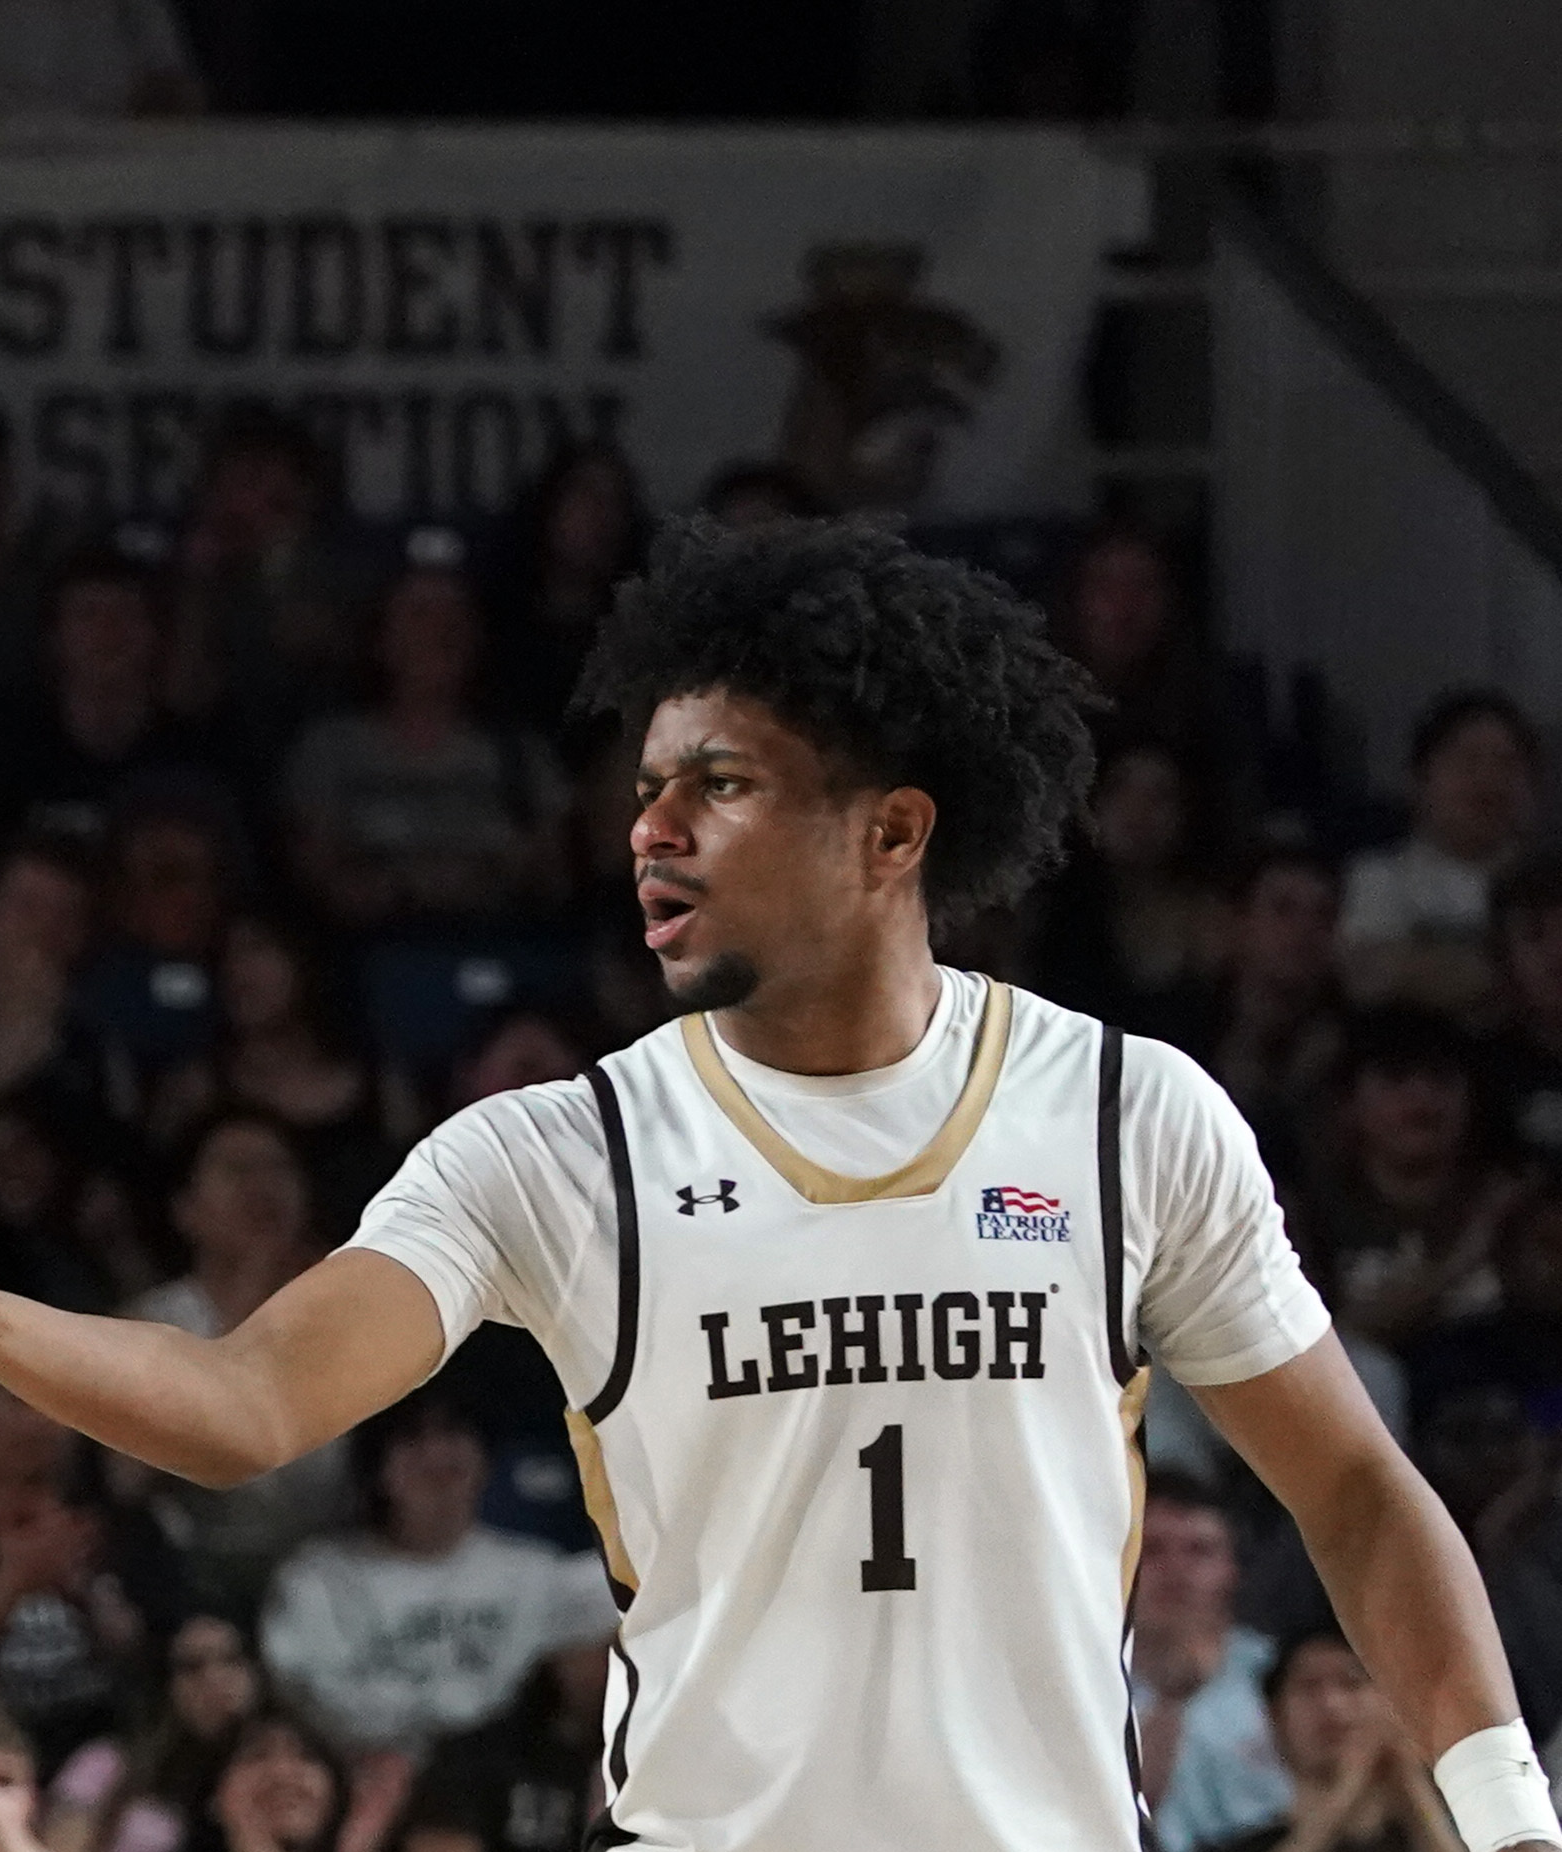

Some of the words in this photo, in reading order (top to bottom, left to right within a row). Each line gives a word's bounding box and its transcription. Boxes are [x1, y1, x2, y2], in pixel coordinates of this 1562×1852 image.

[33, 388, 625, 520] SETION
[975, 1212, 1070, 1233] PATRIOT
[977, 1227, 1072, 1243] LEAGUE
[700, 1291, 1048, 1400] LEHIGH
[859, 1424, 916, 1592] 1
